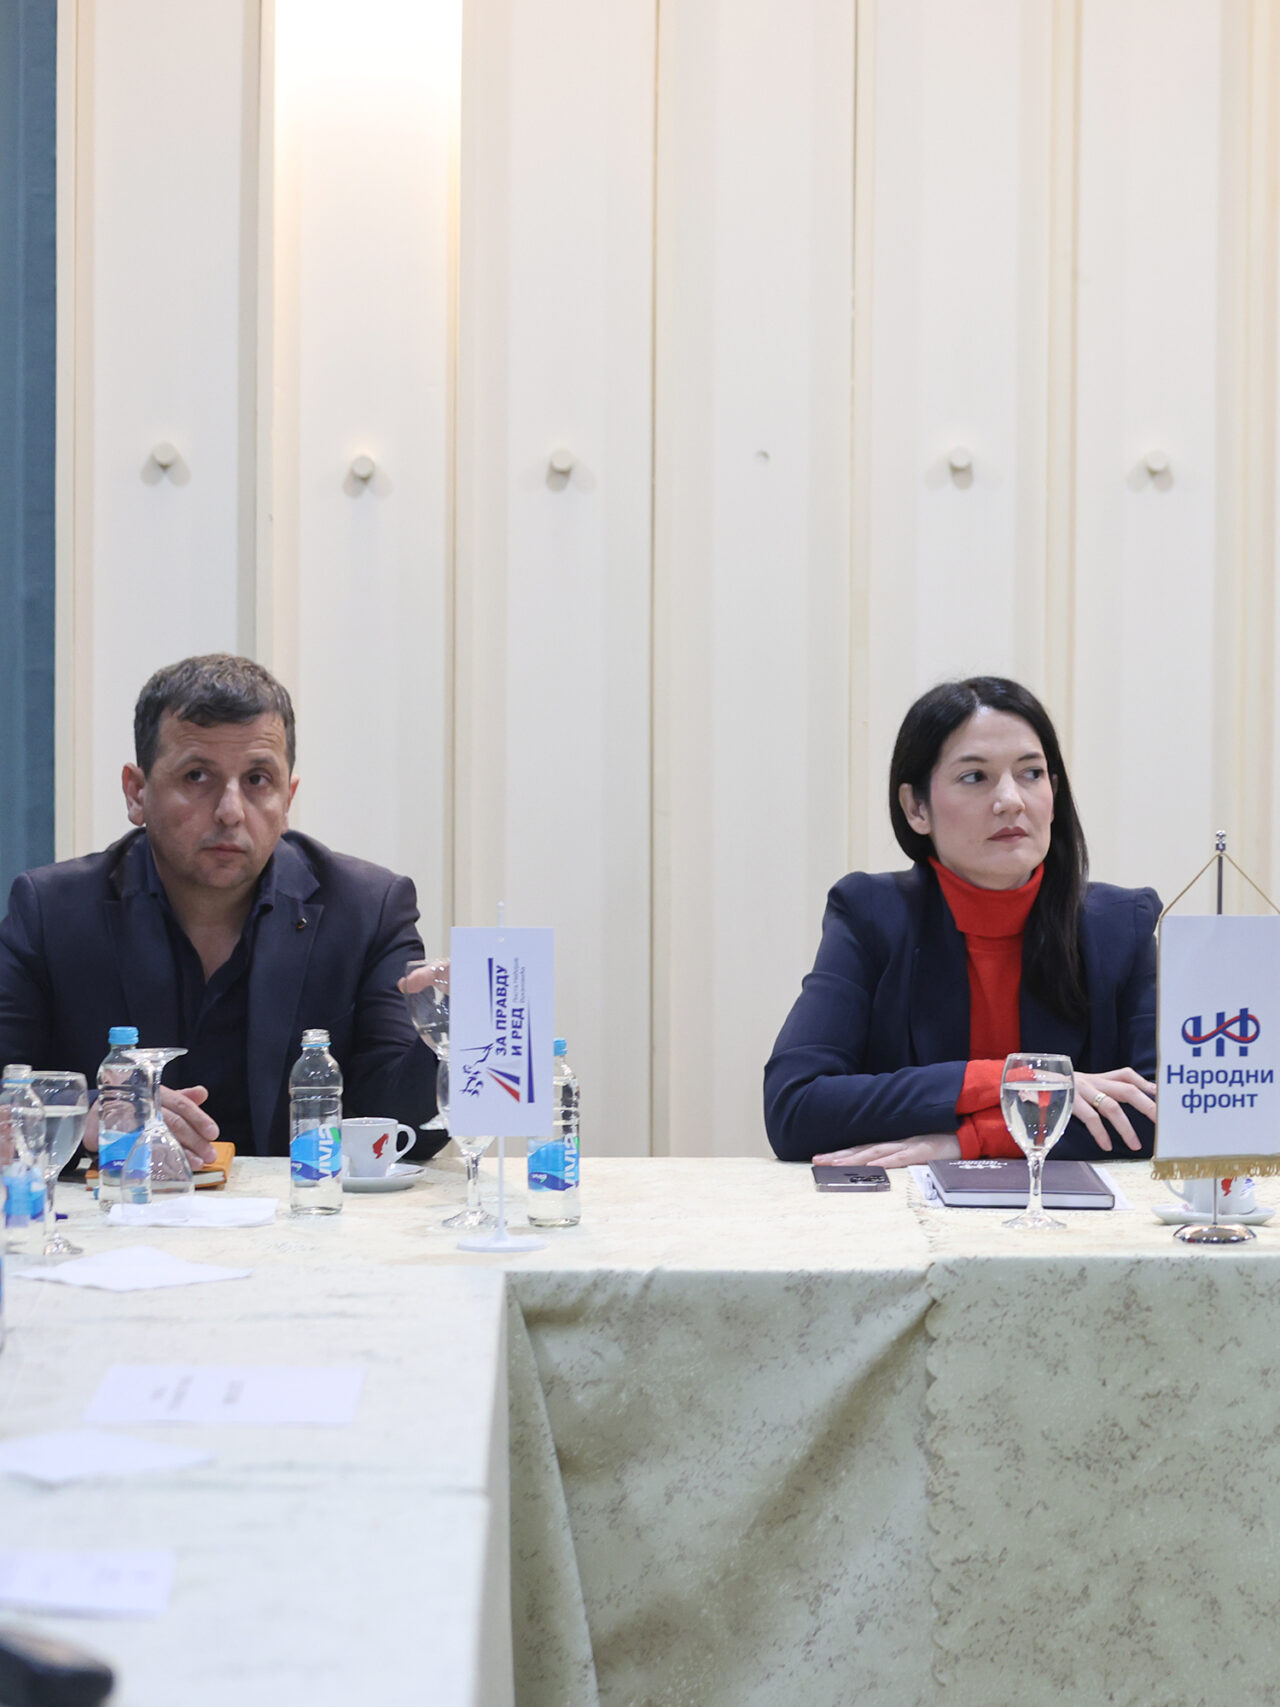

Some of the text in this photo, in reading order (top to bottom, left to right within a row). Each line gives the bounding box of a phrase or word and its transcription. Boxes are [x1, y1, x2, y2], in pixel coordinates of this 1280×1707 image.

[495, 965, 510, 1056] ЗА ПРАВДУ
[511, 1007, 525, 1039] РЕД
[511, 1045, 523, 1056] И
[1167, 1064, 1274, 1089] Народни
[1181, 1088, 1258, 1114] фронт
